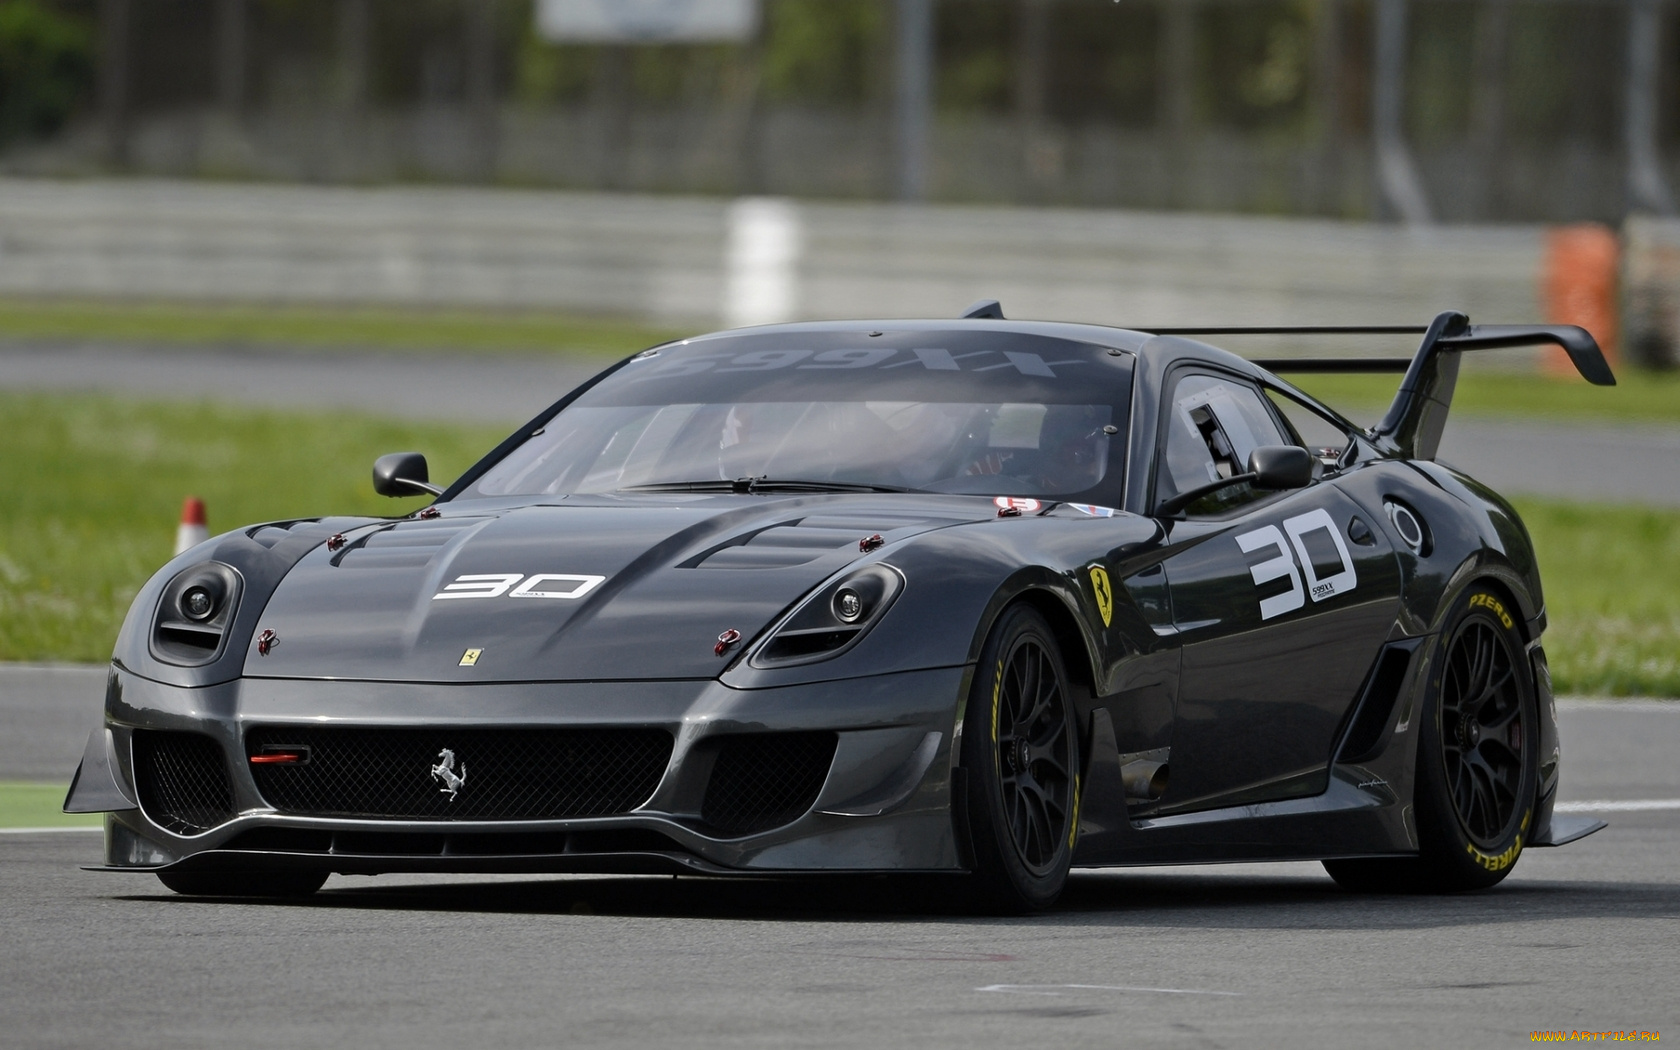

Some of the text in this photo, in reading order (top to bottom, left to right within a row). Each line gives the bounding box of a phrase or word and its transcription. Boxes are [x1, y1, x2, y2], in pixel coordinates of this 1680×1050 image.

[1235, 508, 1357, 620] 30
[432, 573, 606, 599] 30
[1312, 582, 1333, 595] 599XX
[1469, 594, 1513, 629] PZERO
[1467, 834, 1521, 871] PIRELLI
